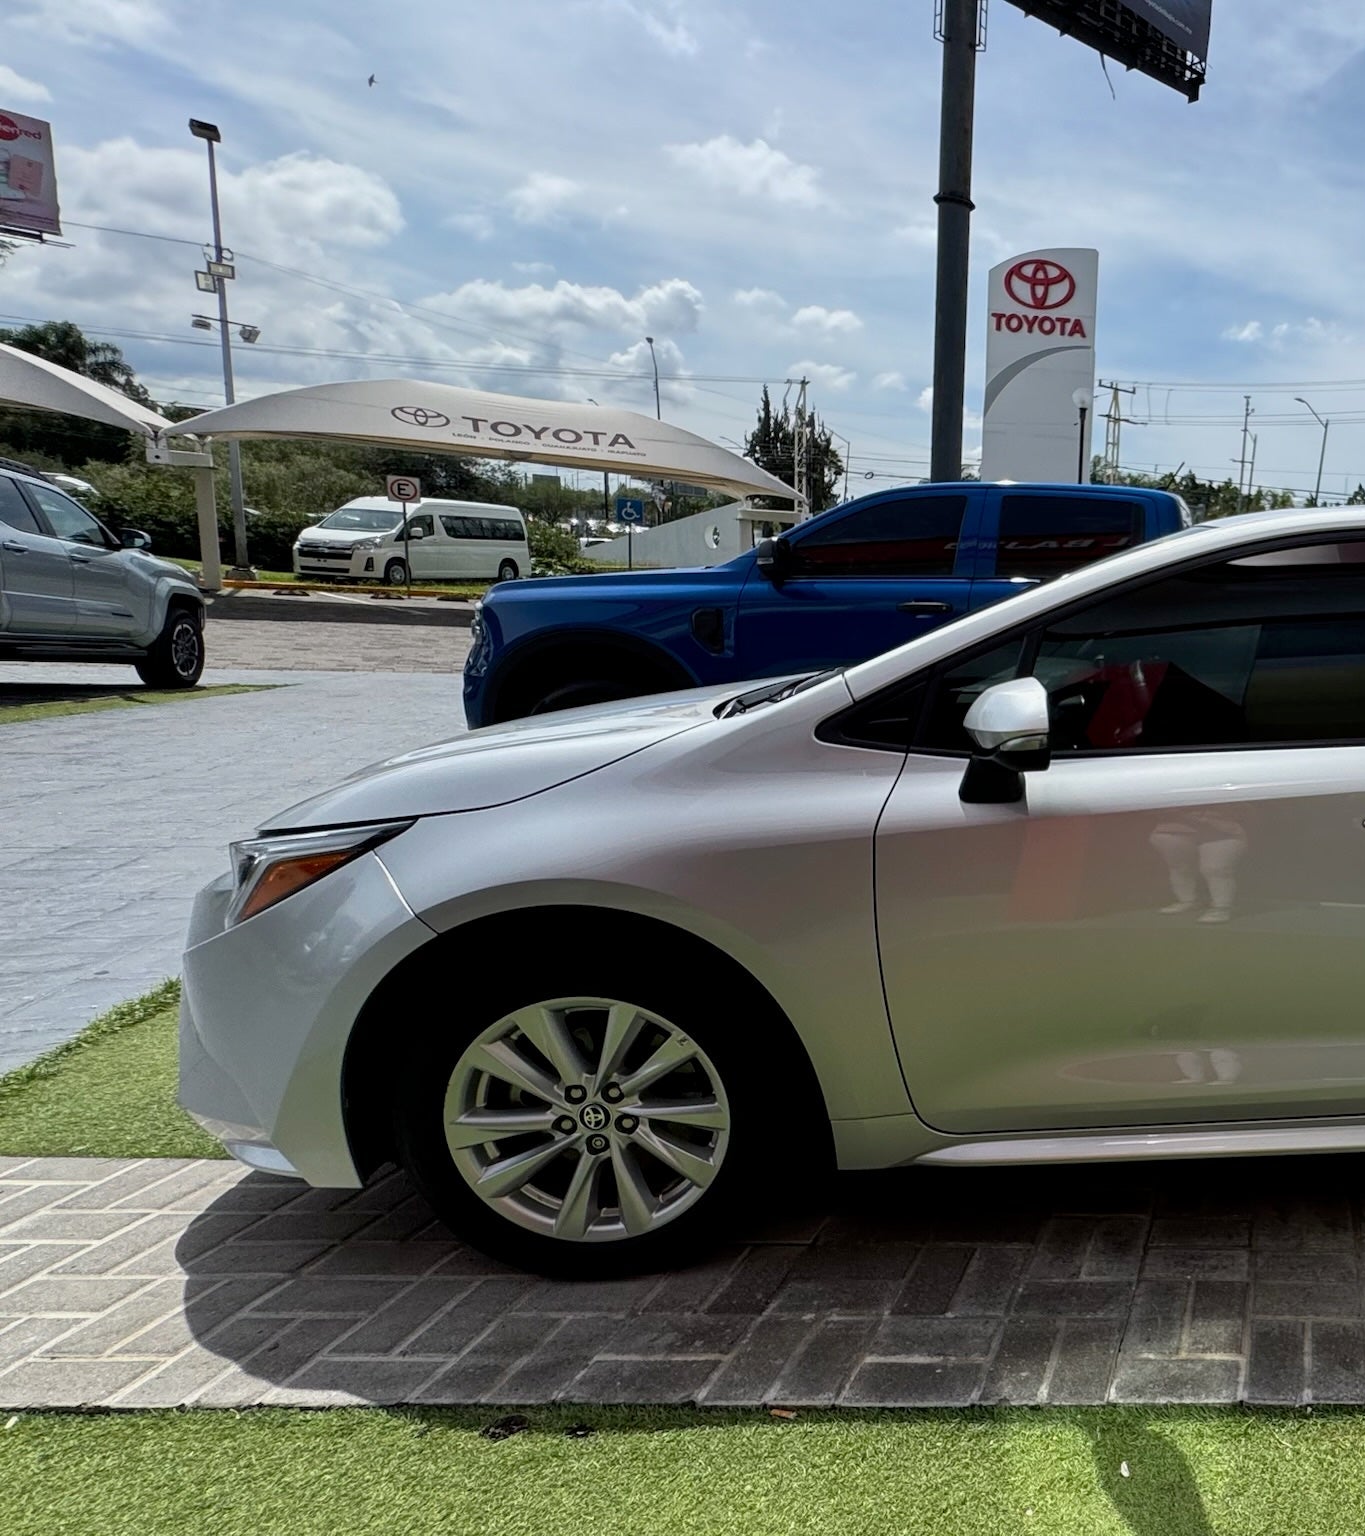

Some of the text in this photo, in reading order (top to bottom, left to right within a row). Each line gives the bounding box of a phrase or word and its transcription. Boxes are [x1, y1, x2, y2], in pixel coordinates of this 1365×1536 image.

[991, 312, 1087, 338] TOYOTA
[461, 415, 636, 449] TOYOTA
[397, 482, 411, 497] E
